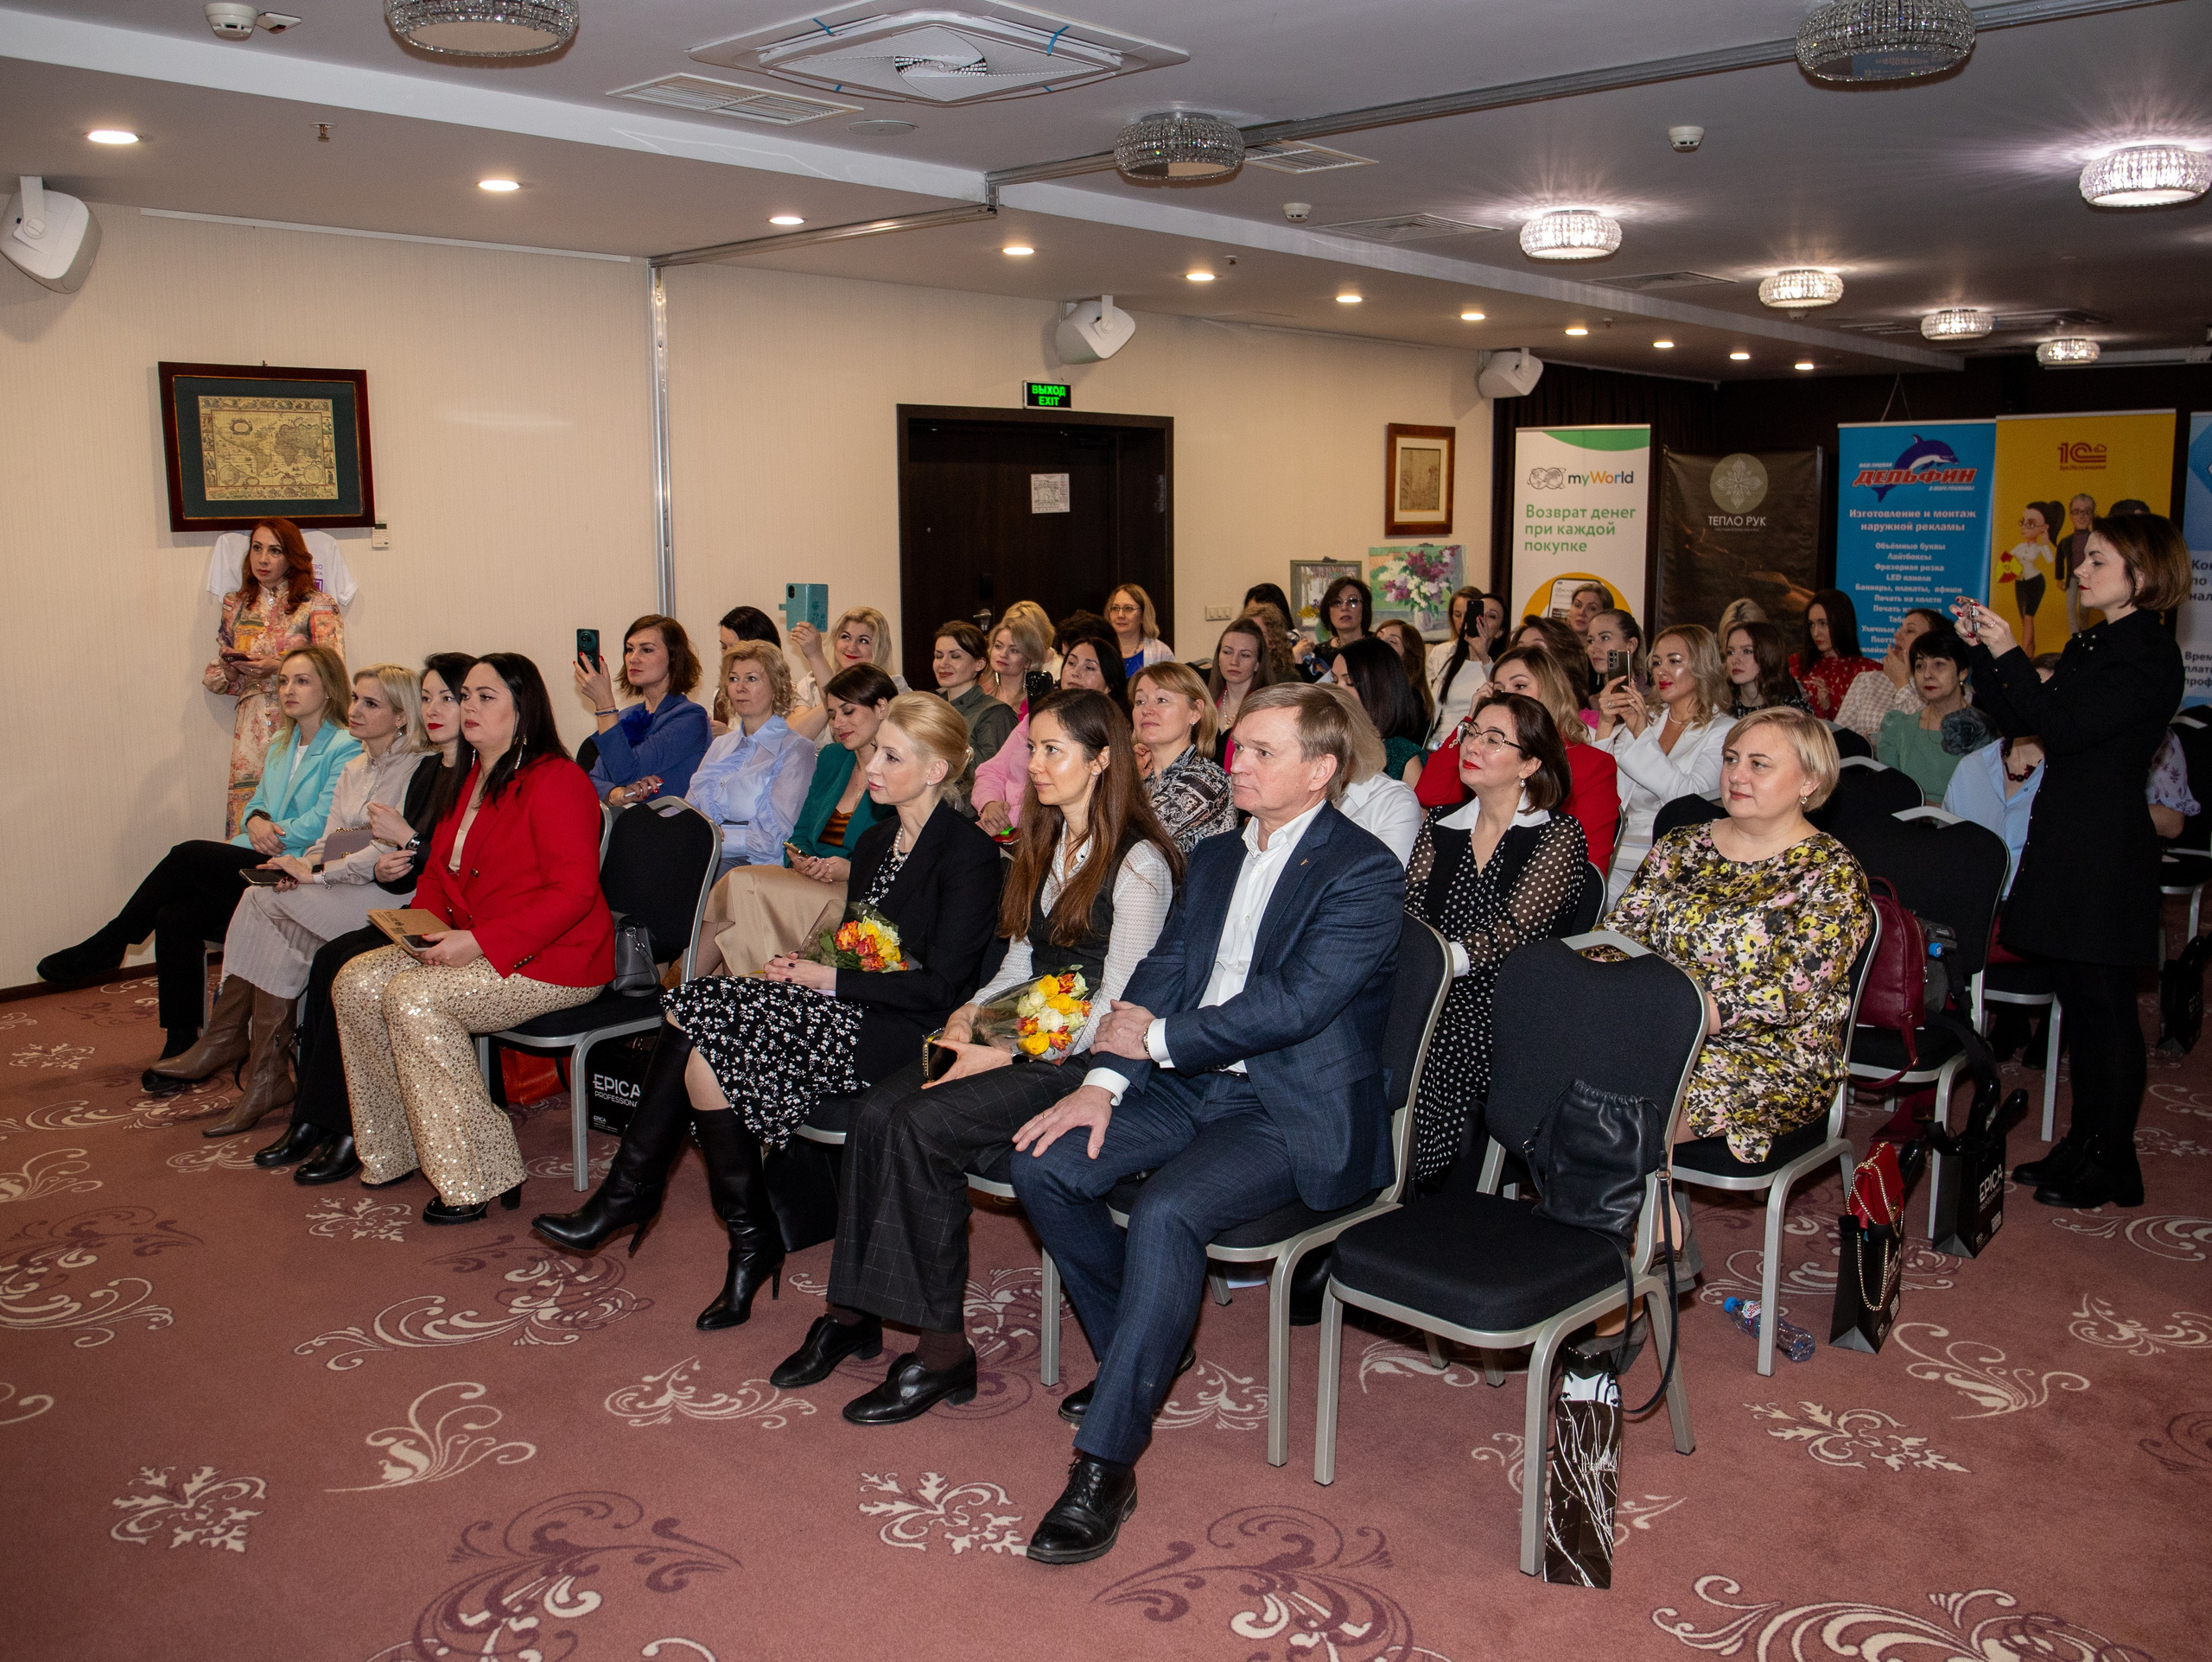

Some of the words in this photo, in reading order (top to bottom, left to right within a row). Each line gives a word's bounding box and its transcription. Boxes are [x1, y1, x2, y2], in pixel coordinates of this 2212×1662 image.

[1032, 384, 1066, 397] ВЫХОД
[1039, 396, 1060, 406] EXIT
[1568, 471, 1634, 486] myWorld
[1853, 468, 1977, 486] ДЕЛЬФИН
[1526, 504, 1587, 522] Возврат
[1591, 508, 1637, 520] денег
[1849, 509, 1921, 518] Изготовление
[1923, 510, 1930, 518] и
[1933, 510, 1976, 518] монтаж
[1708, 516, 1744, 527] ТЕПЛО
[1745, 516, 1767, 527] РУК
[1860, 521, 1913, 532] наружной
[1916, 523, 1965, 532] рекламы
[1524, 524, 1553, 538] при
[1557, 521, 1616, 536] каждой
[1524, 542, 1587, 555] покупке
[1920, 542, 1946, 551] буквы
[1874, 562, 1918, 571] Фрезерная
[1934, 586, 1963, 594] афиши
[1874, 594, 1902, 603] Печать
[593, 1074, 641, 1099] EPICA
[1979, 1164, 2004, 1203] EPICA
